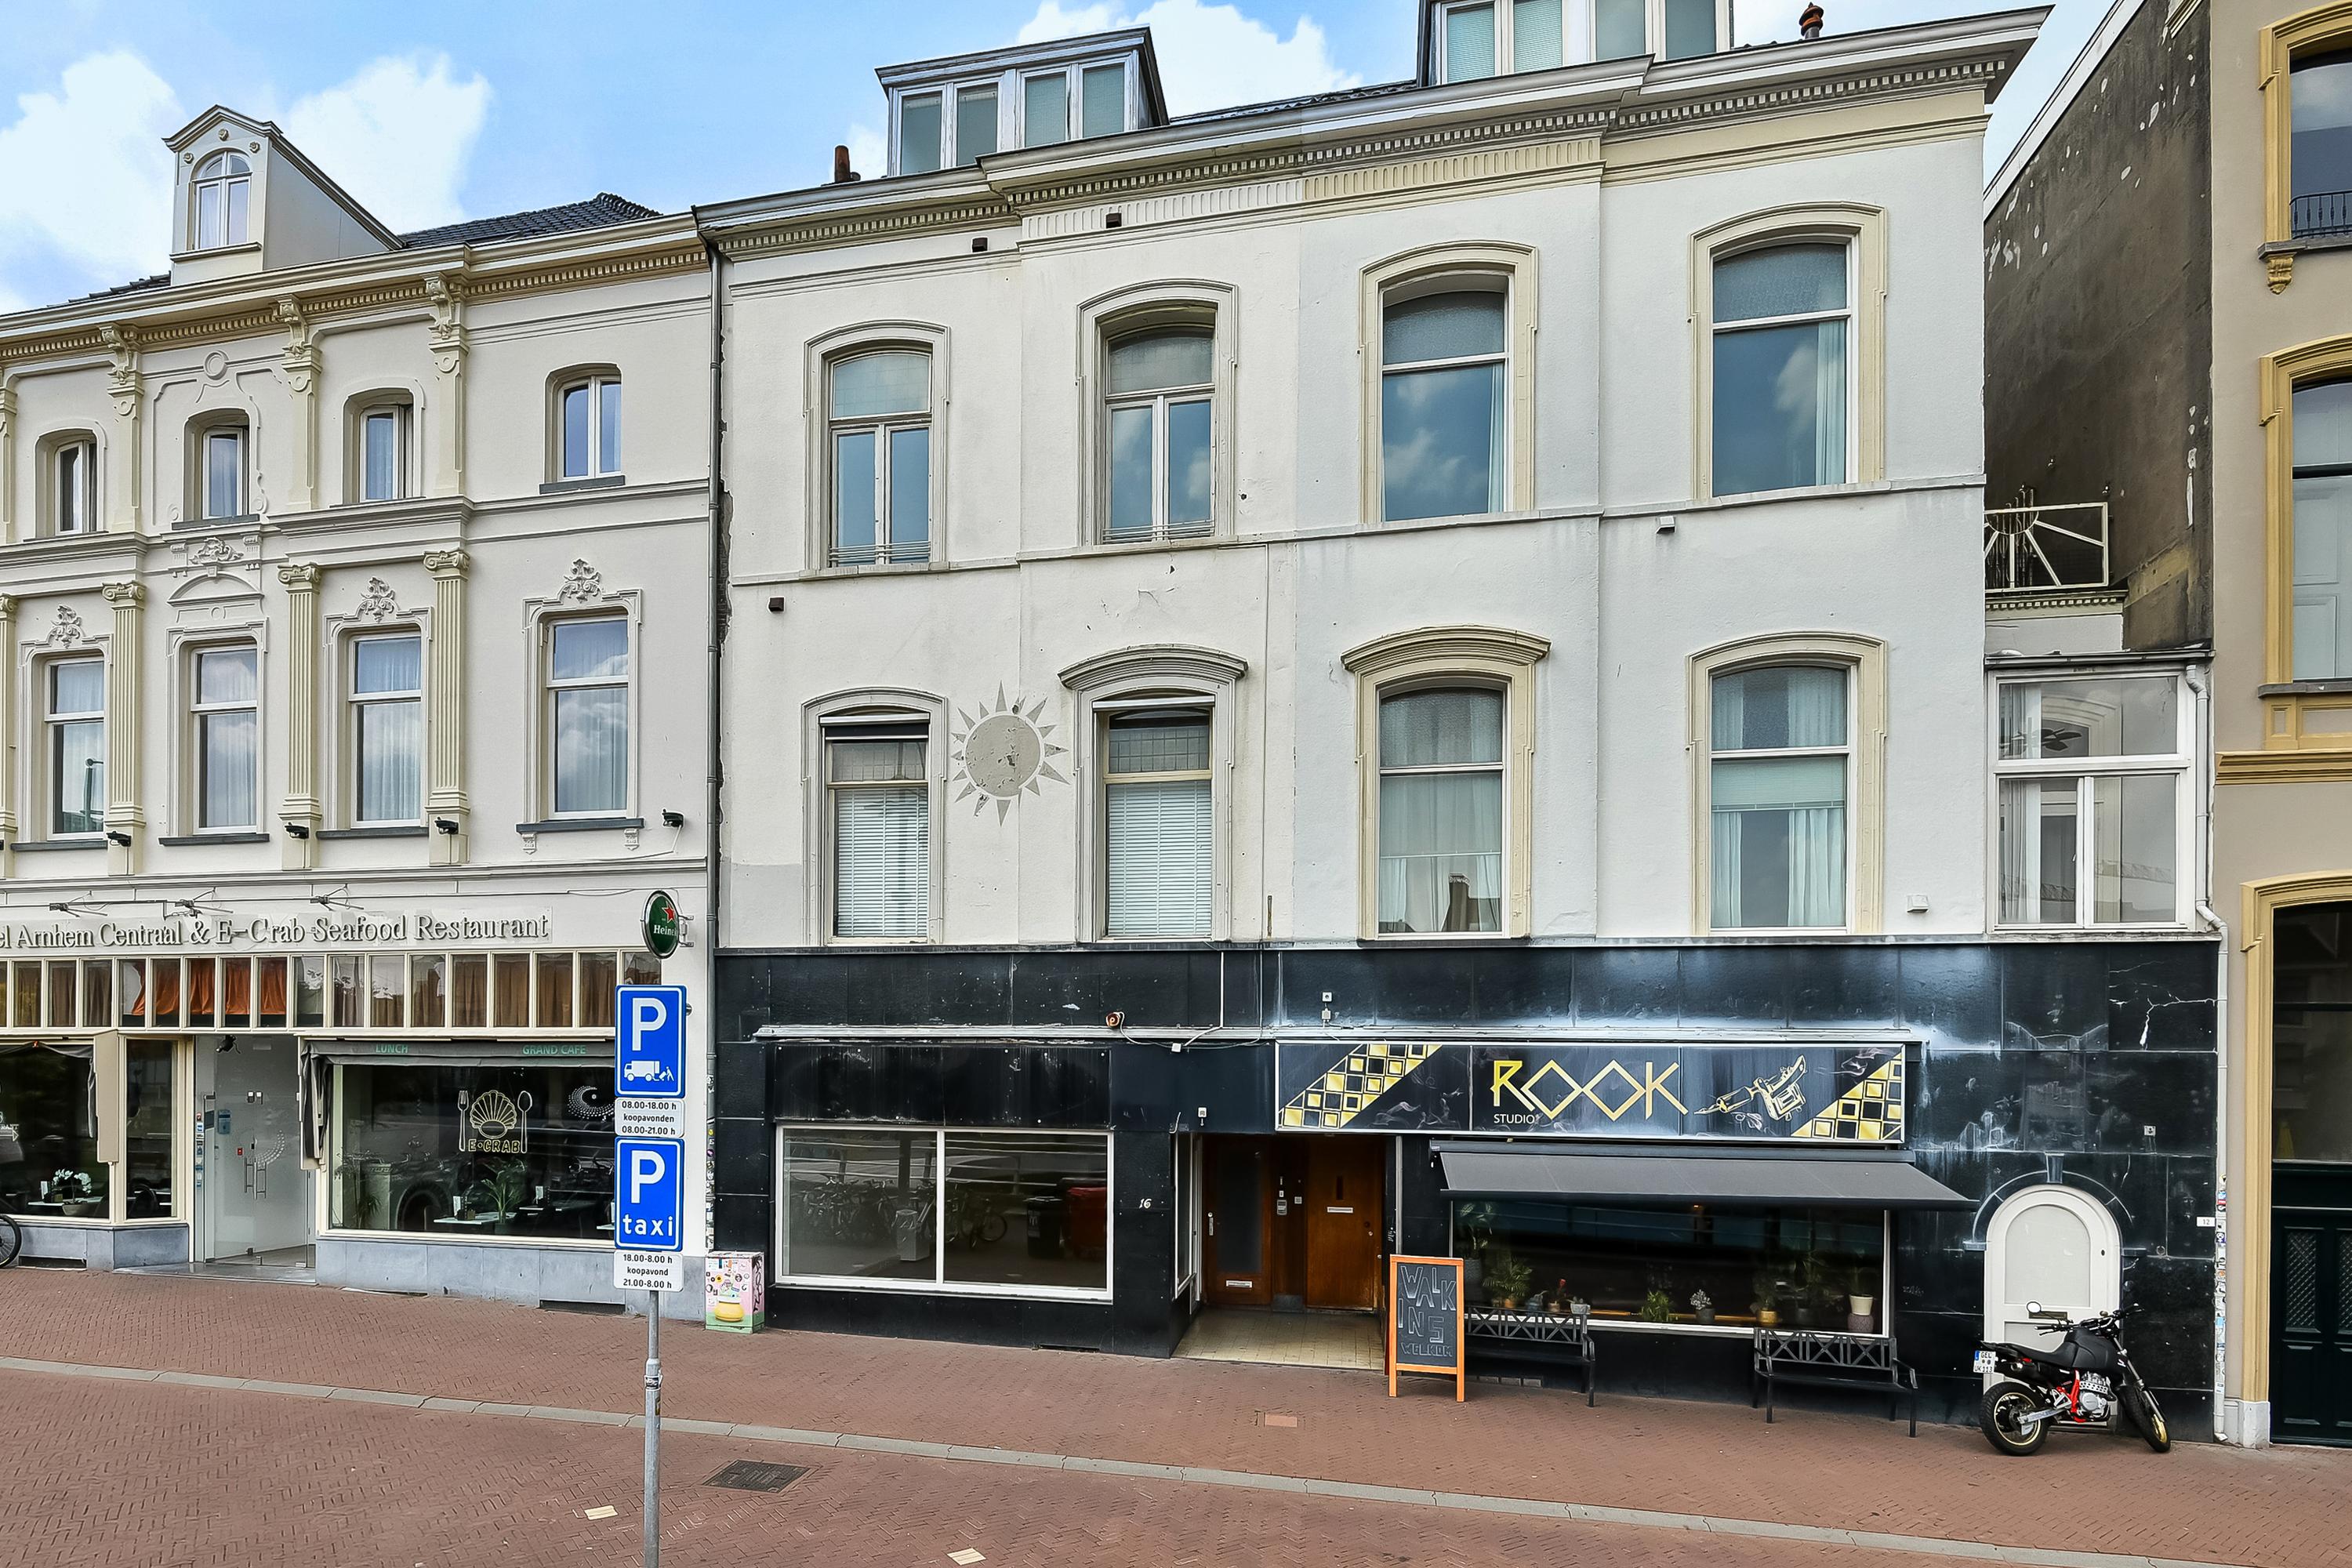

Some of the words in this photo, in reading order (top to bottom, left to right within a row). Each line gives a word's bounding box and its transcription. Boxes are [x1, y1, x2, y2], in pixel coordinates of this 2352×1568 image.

[16, 924, 94, 948] Arnhem
[99, 920, 183, 947] Centraal
[190, 920, 210, 945] &
[312, 915, 408, 942] Seafood
[413, 915, 549, 941] Restaurant
[632, 997, 667, 1051] P
[376, 1044, 408, 1054] LUNCH
[522, 1045, 558, 1054] GRAND
[1490, 1059, 1689, 1122] ROOK
[621, 1101, 670, 1110] 08.00-18.00
[671, 1102, 677, 1110] h
[623, 1113, 675, 1123] koopavonden
[1493, 1113, 1535, 1124] STUDIO
[621, 1125, 669, 1135] 08.00-21.00
[670, 1127, 676, 1135] h
[630, 1150, 666, 1203] P
[1138, 1198, 1152, 1209] 16
[622, 1214, 673, 1237] taxi
[622, 1254, 666, 1264] 18.00-8.00
[626, 1267, 669, 1276] koopavond
[622, 1278, 665, 1288] 21.00-8.00
[666, 1279, 672, 1289] h
[1400, 1265, 1457, 1311] WALK
[1400, 1341, 1453, 1357] WELKOM
